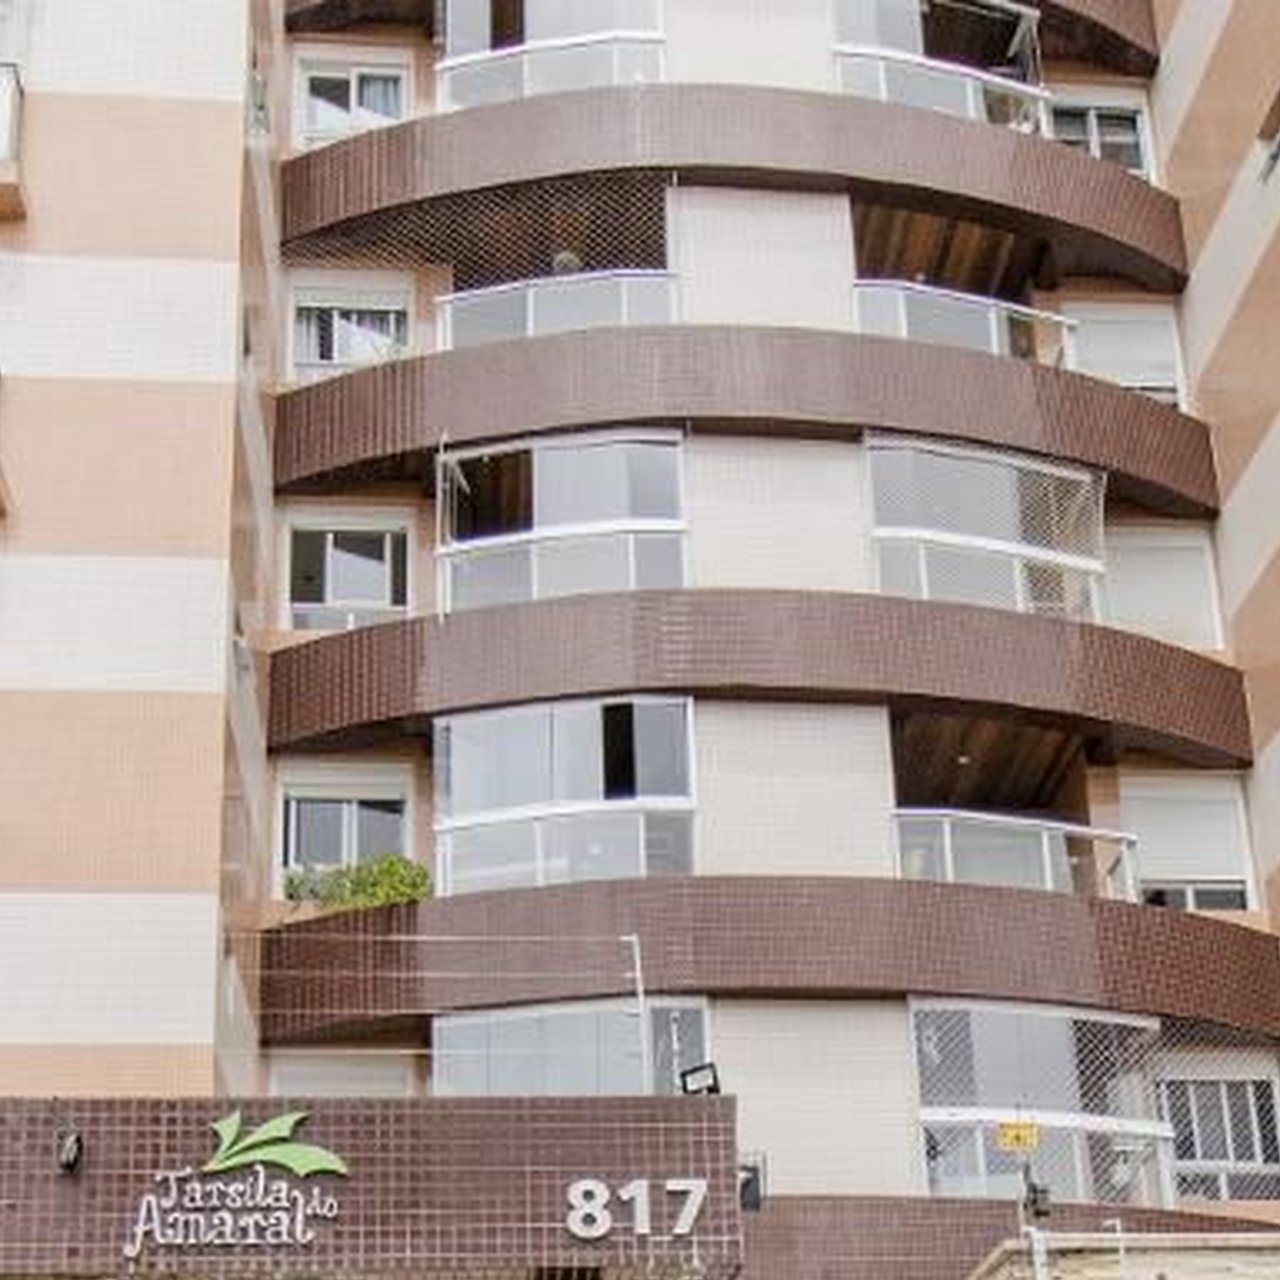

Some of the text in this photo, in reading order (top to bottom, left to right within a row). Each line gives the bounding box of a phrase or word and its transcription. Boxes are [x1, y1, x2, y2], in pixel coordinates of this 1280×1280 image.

[155, 1164, 339, 1217] Tarsila do
[566, 1178, 708, 1239] 817
[123, 1189, 315, 1257] Amaral
